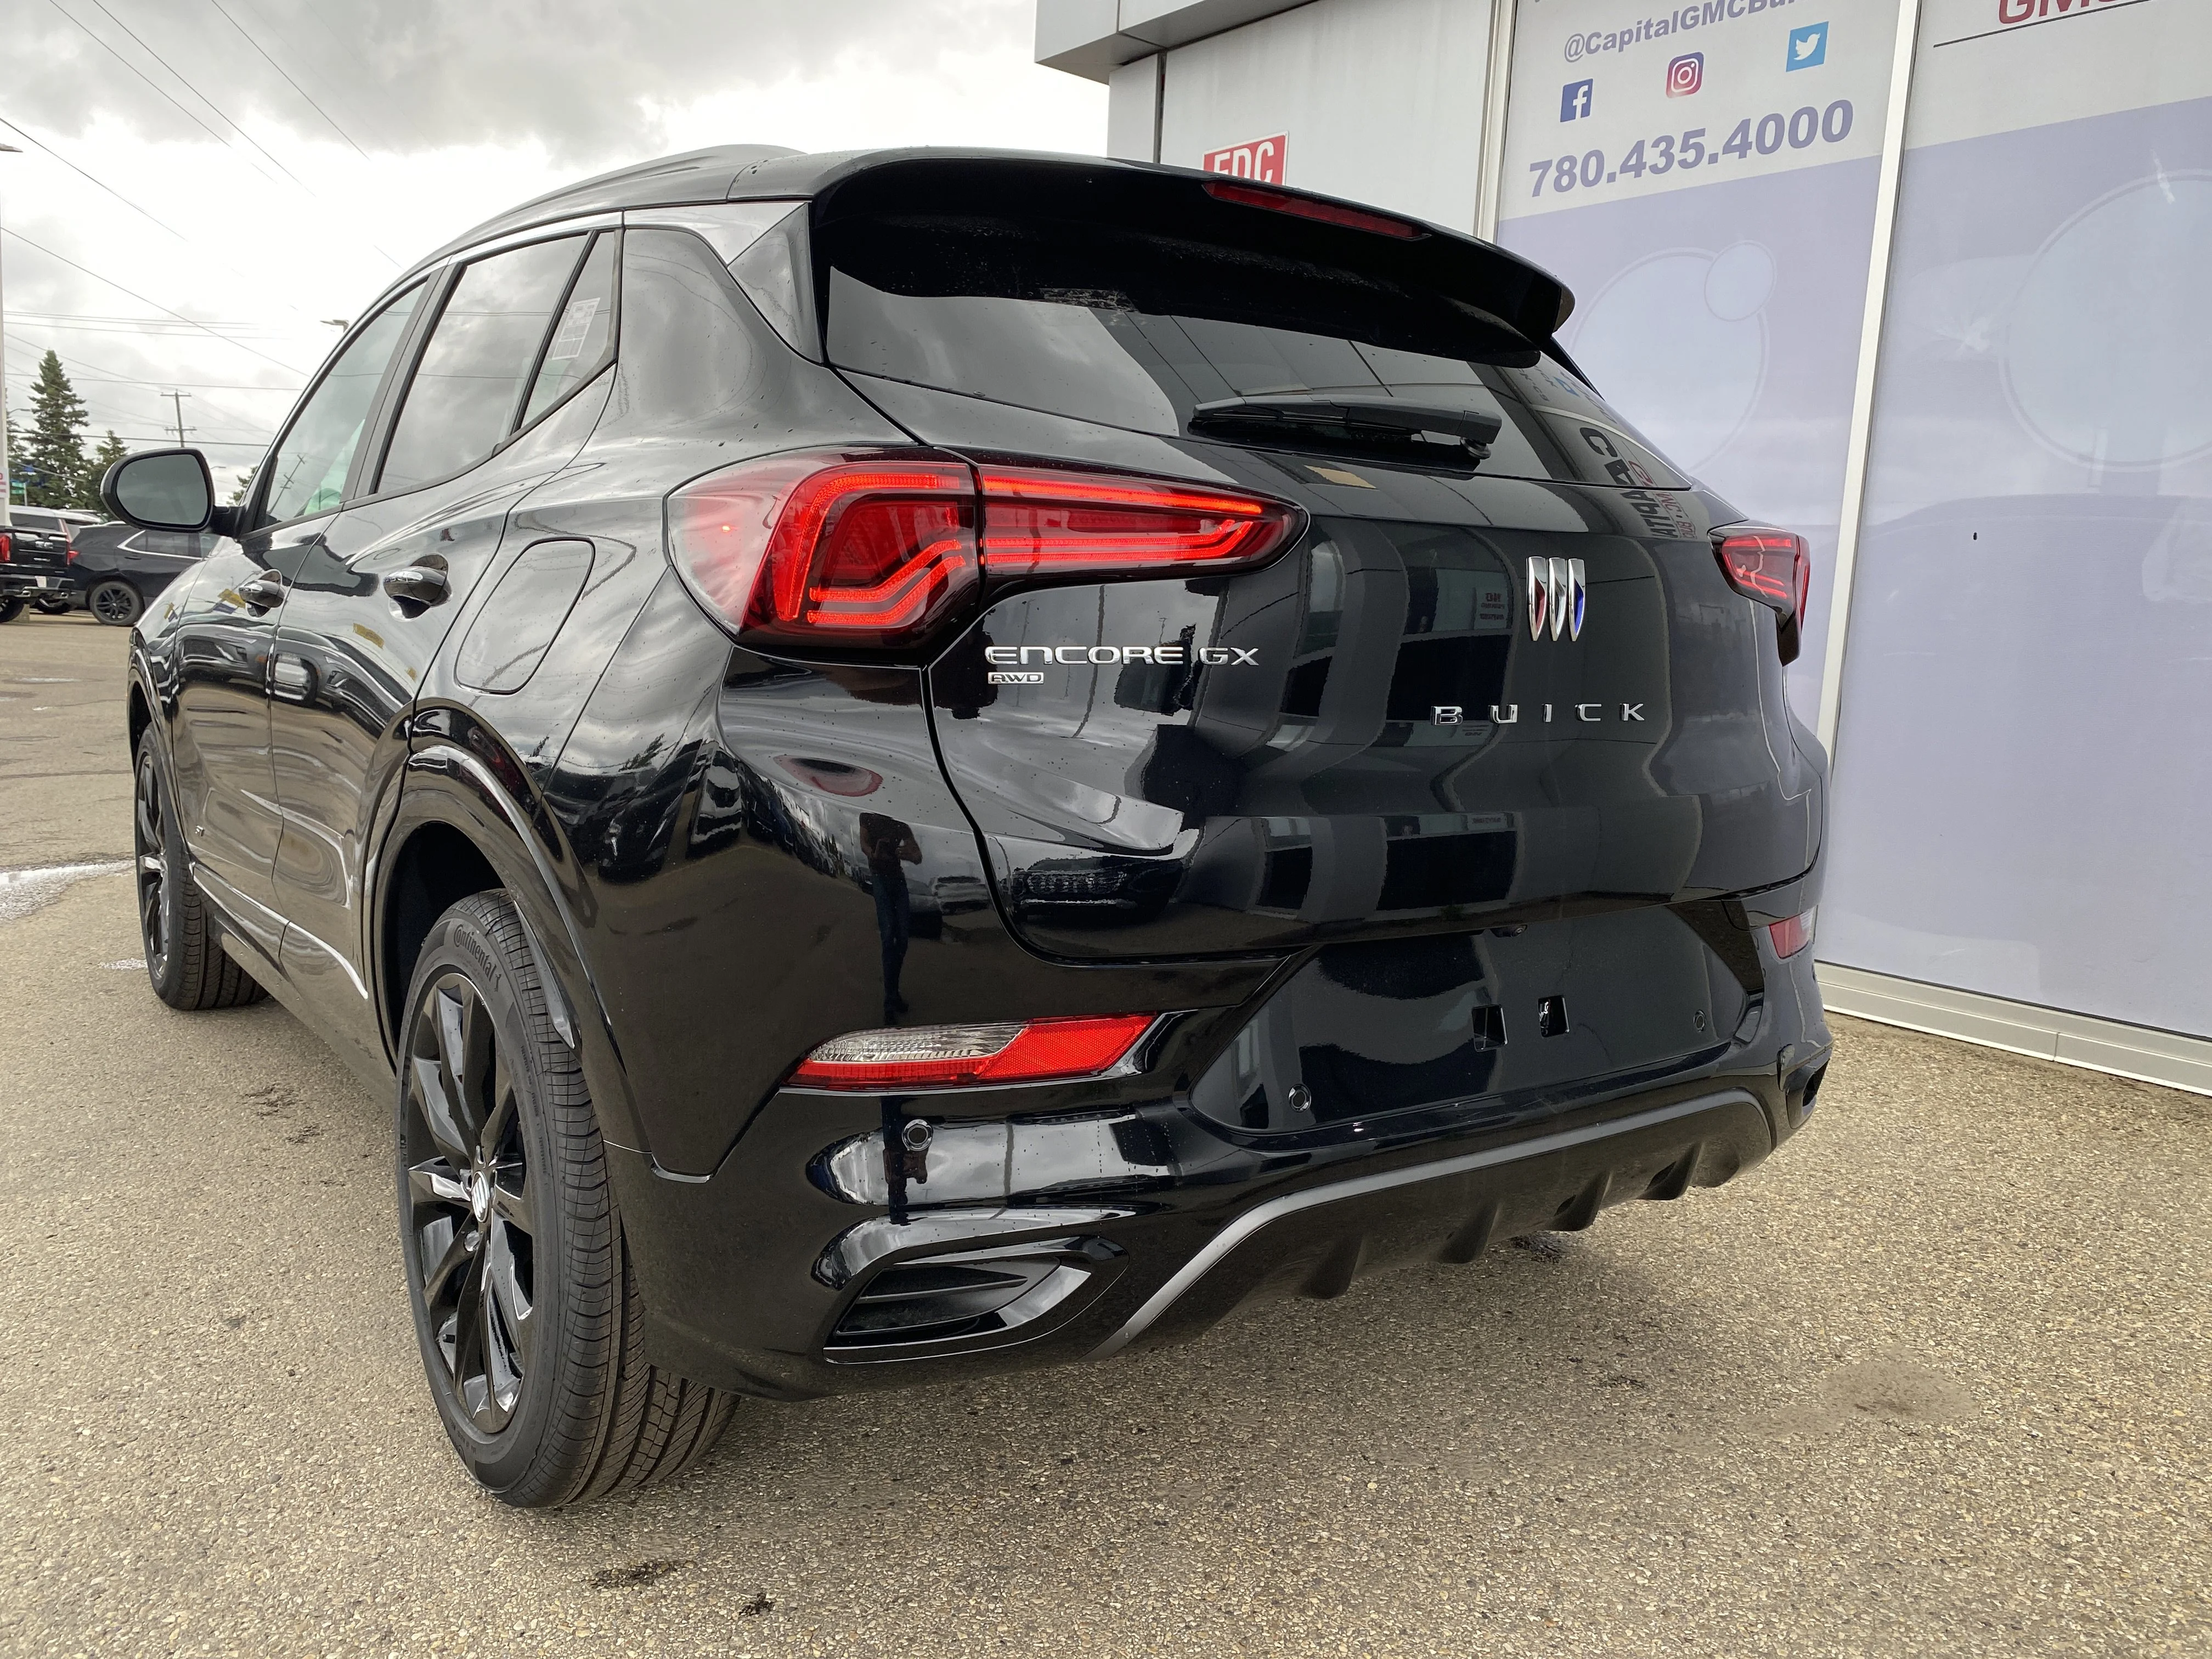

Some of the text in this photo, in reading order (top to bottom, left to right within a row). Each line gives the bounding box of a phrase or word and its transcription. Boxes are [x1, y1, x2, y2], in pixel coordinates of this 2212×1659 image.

[1529, 99, 1854, 198] 780.435.4000
[985, 646, 1260, 666] ENCORE GX
[990, 673, 1042, 683] AWD
[1431, 703, 1645, 726] BUICK
[454, 924, 497, 982] Continental
